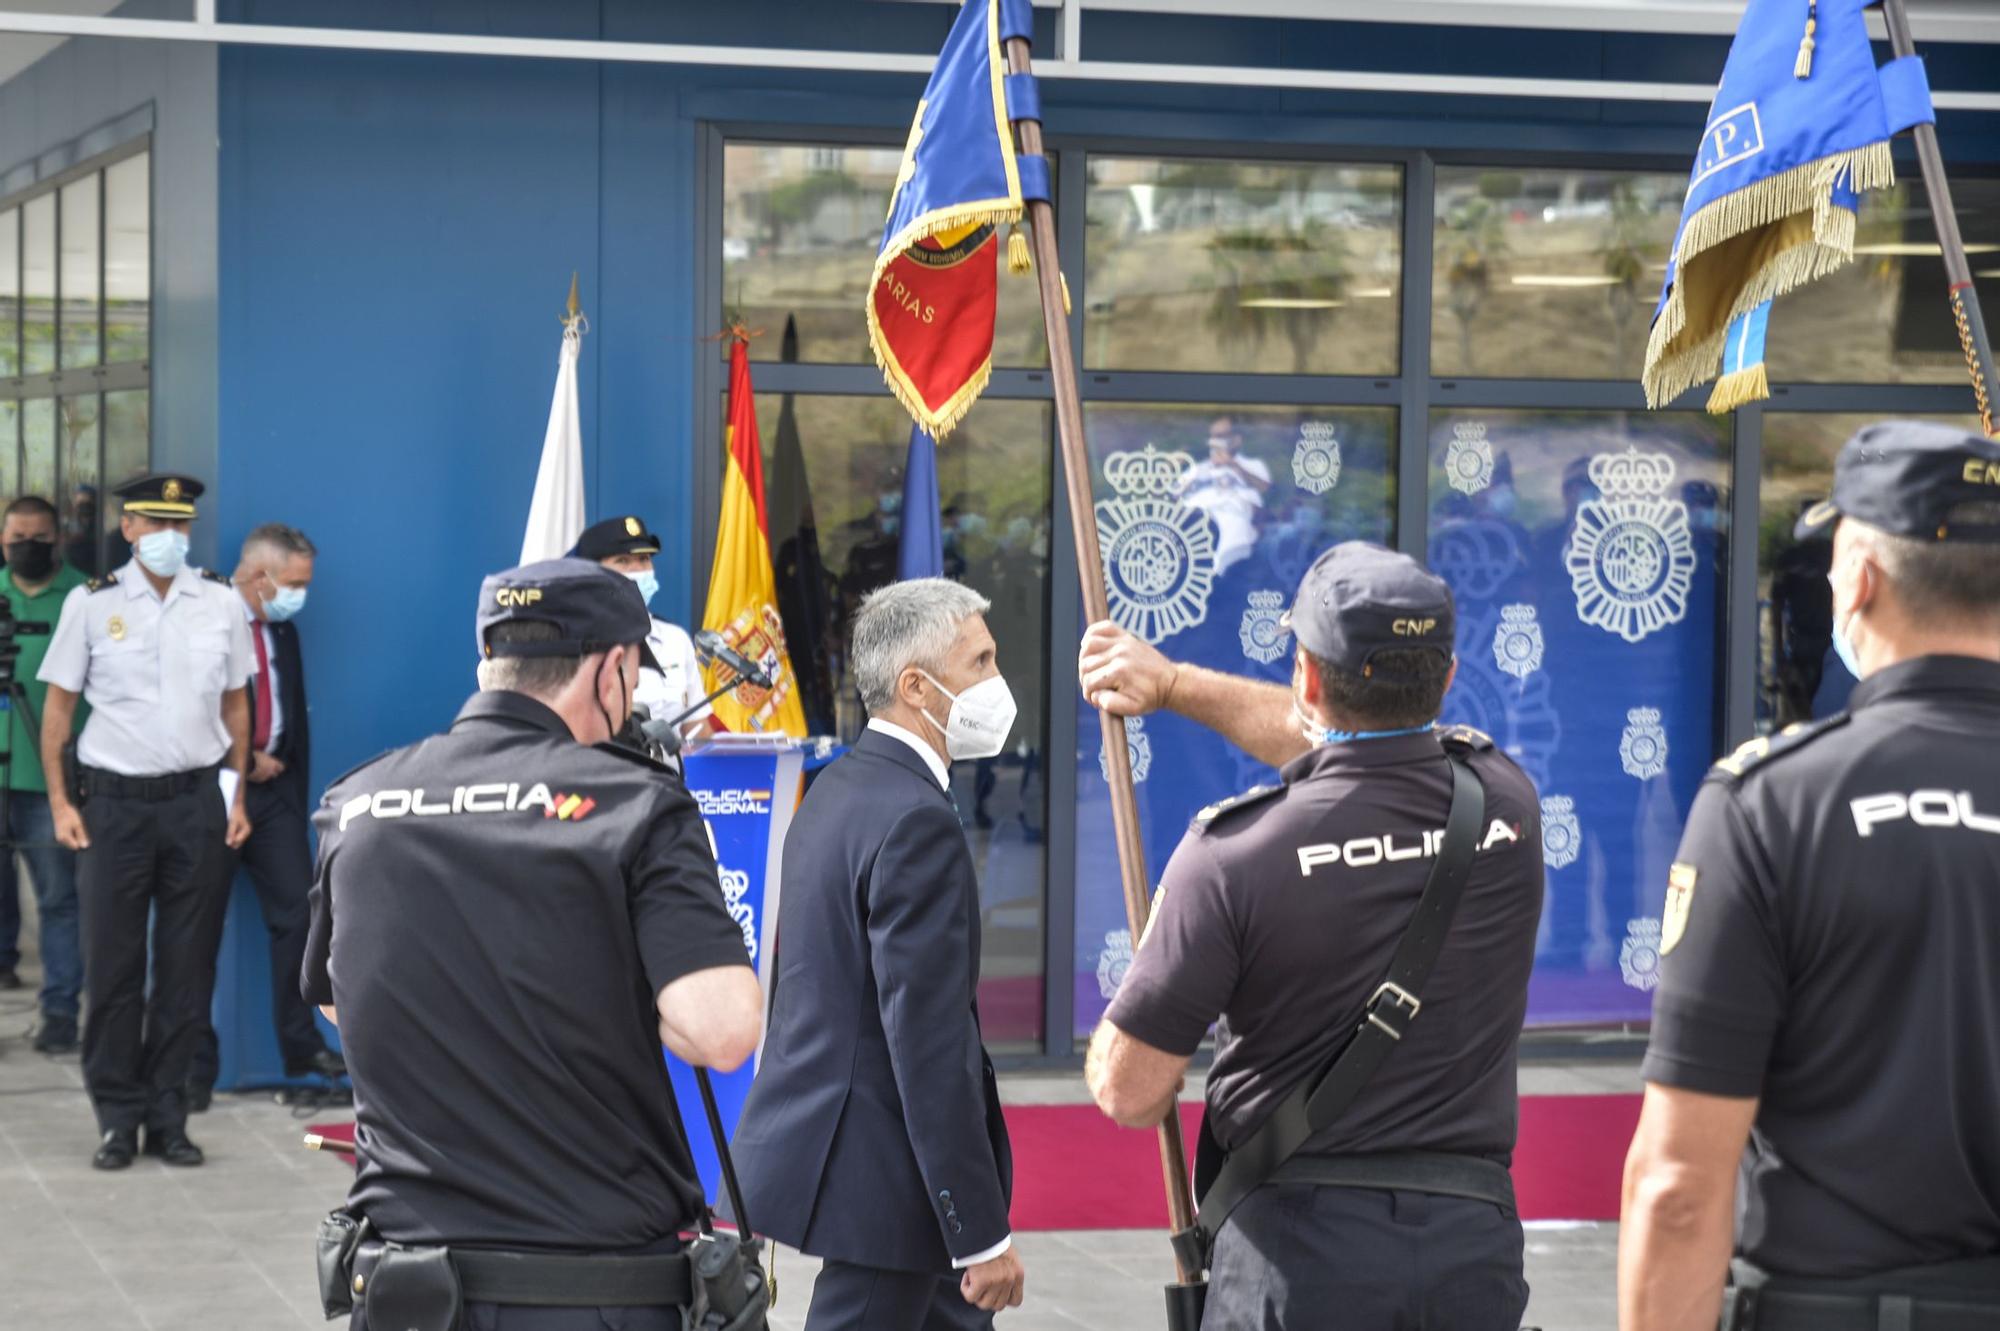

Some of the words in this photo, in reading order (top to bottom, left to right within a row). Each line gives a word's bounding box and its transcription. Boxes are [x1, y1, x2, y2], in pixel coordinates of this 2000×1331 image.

[1696, 122, 1750, 176] .P.
[882, 272, 935, 323] ARIAS
[496, 588, 543, 607] CNP
[1392, 617, 1436, 636] CNP
[339, 783, 556, 832] POLICIA
[1850, 789, 2000, 837] POL
[1297, 819, 1517, 877] POLIA
